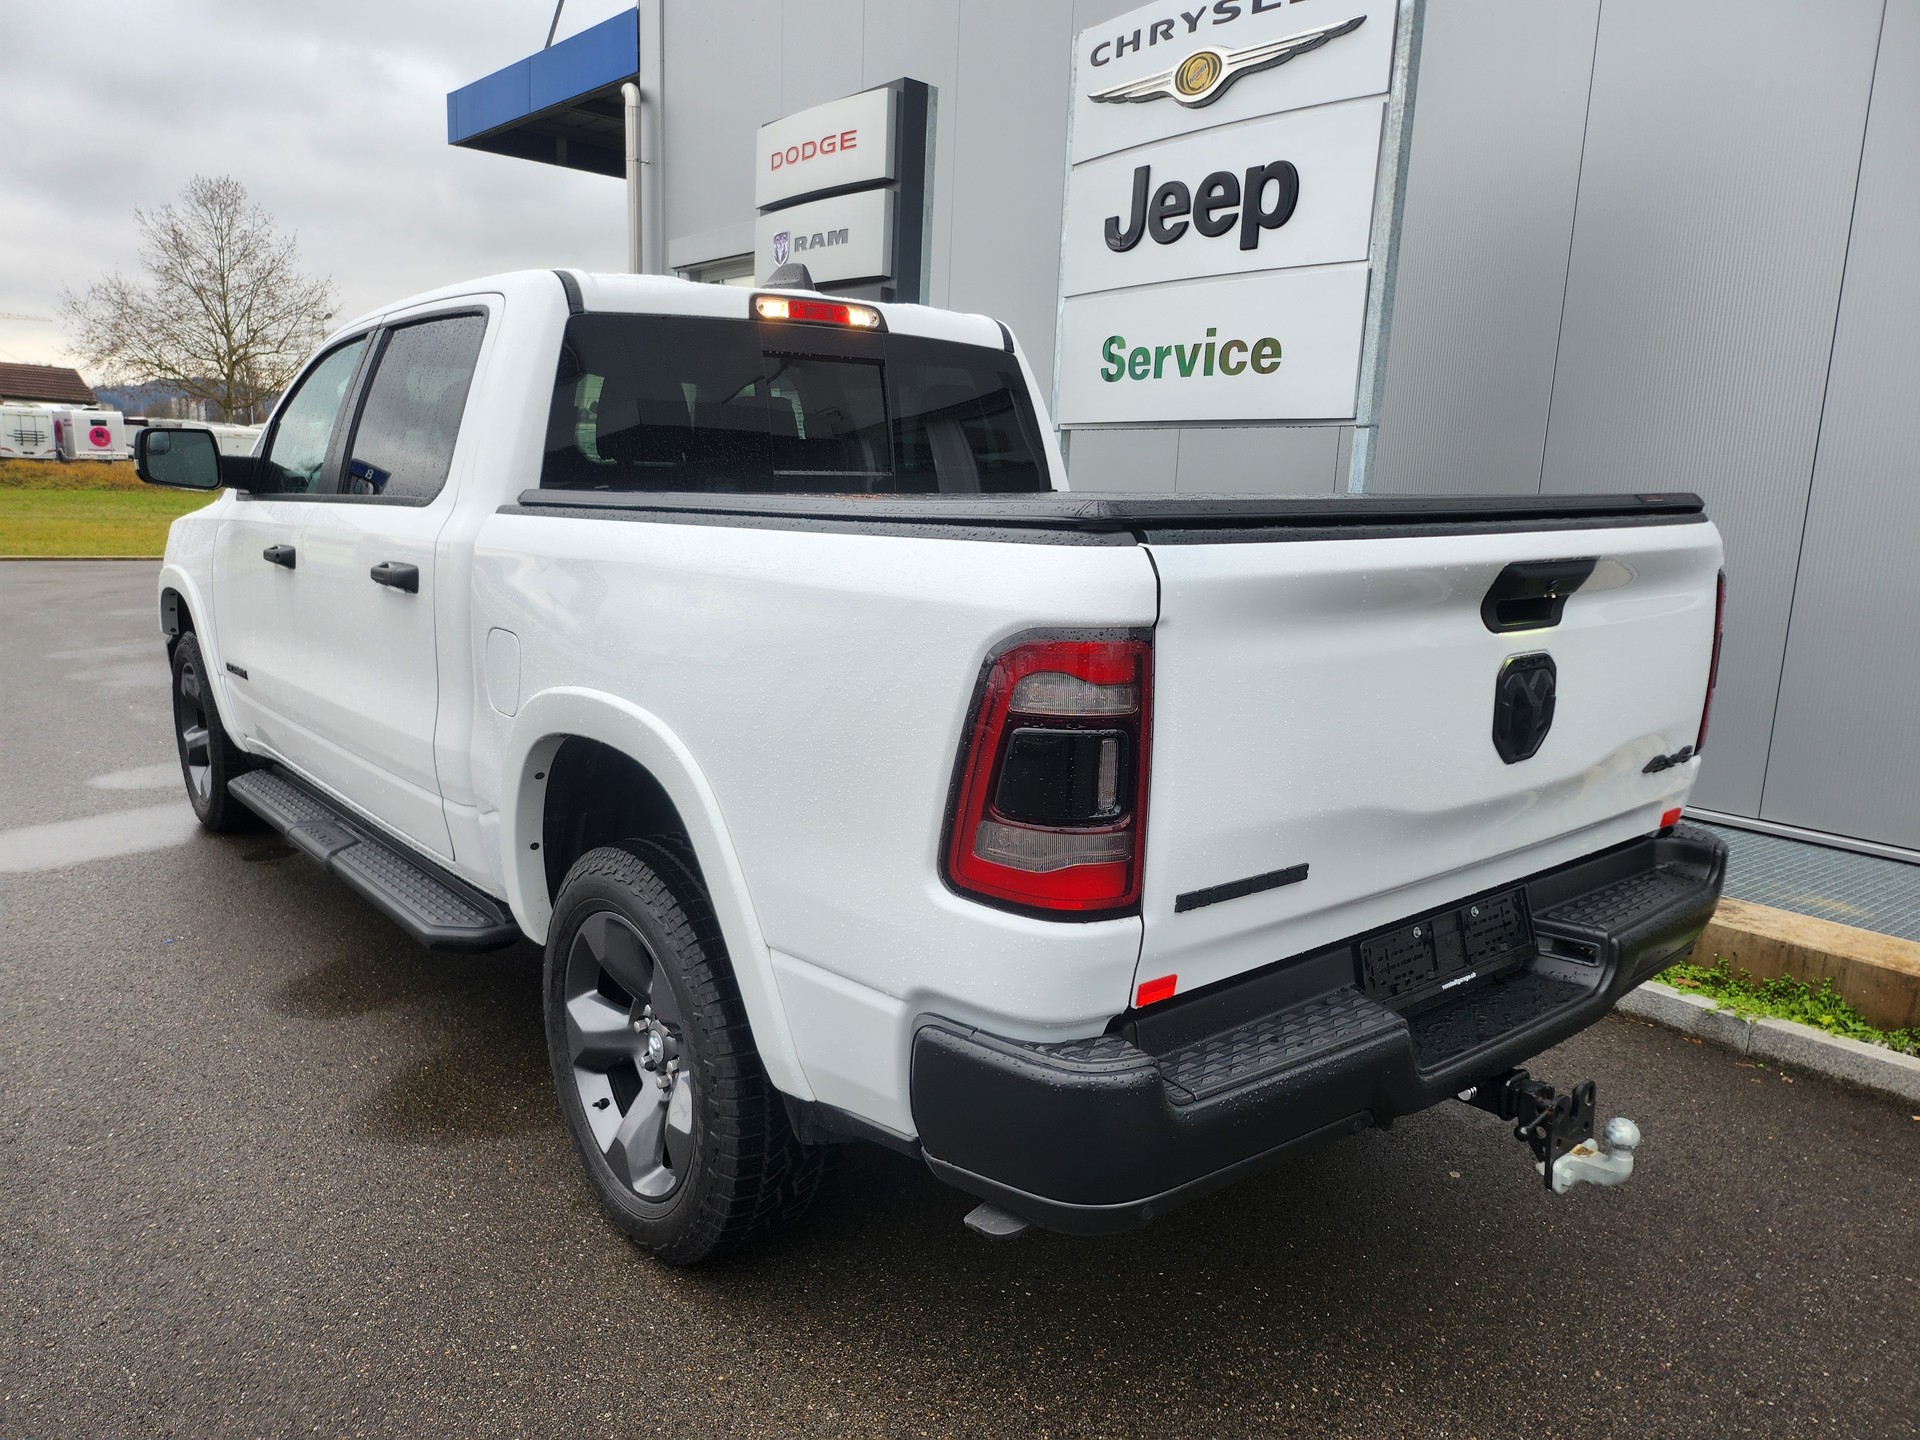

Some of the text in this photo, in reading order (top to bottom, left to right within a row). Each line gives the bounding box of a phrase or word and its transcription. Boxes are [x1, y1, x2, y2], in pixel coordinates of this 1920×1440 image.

[1090, 0, 1308, 68] CHRYSL
[771, 129, 858, 171] DODGE
[1104, 160, 1300, 253] Jeep
[794, 228, 849, 252] RAM
[1100, 327, 1282, 383] Service
